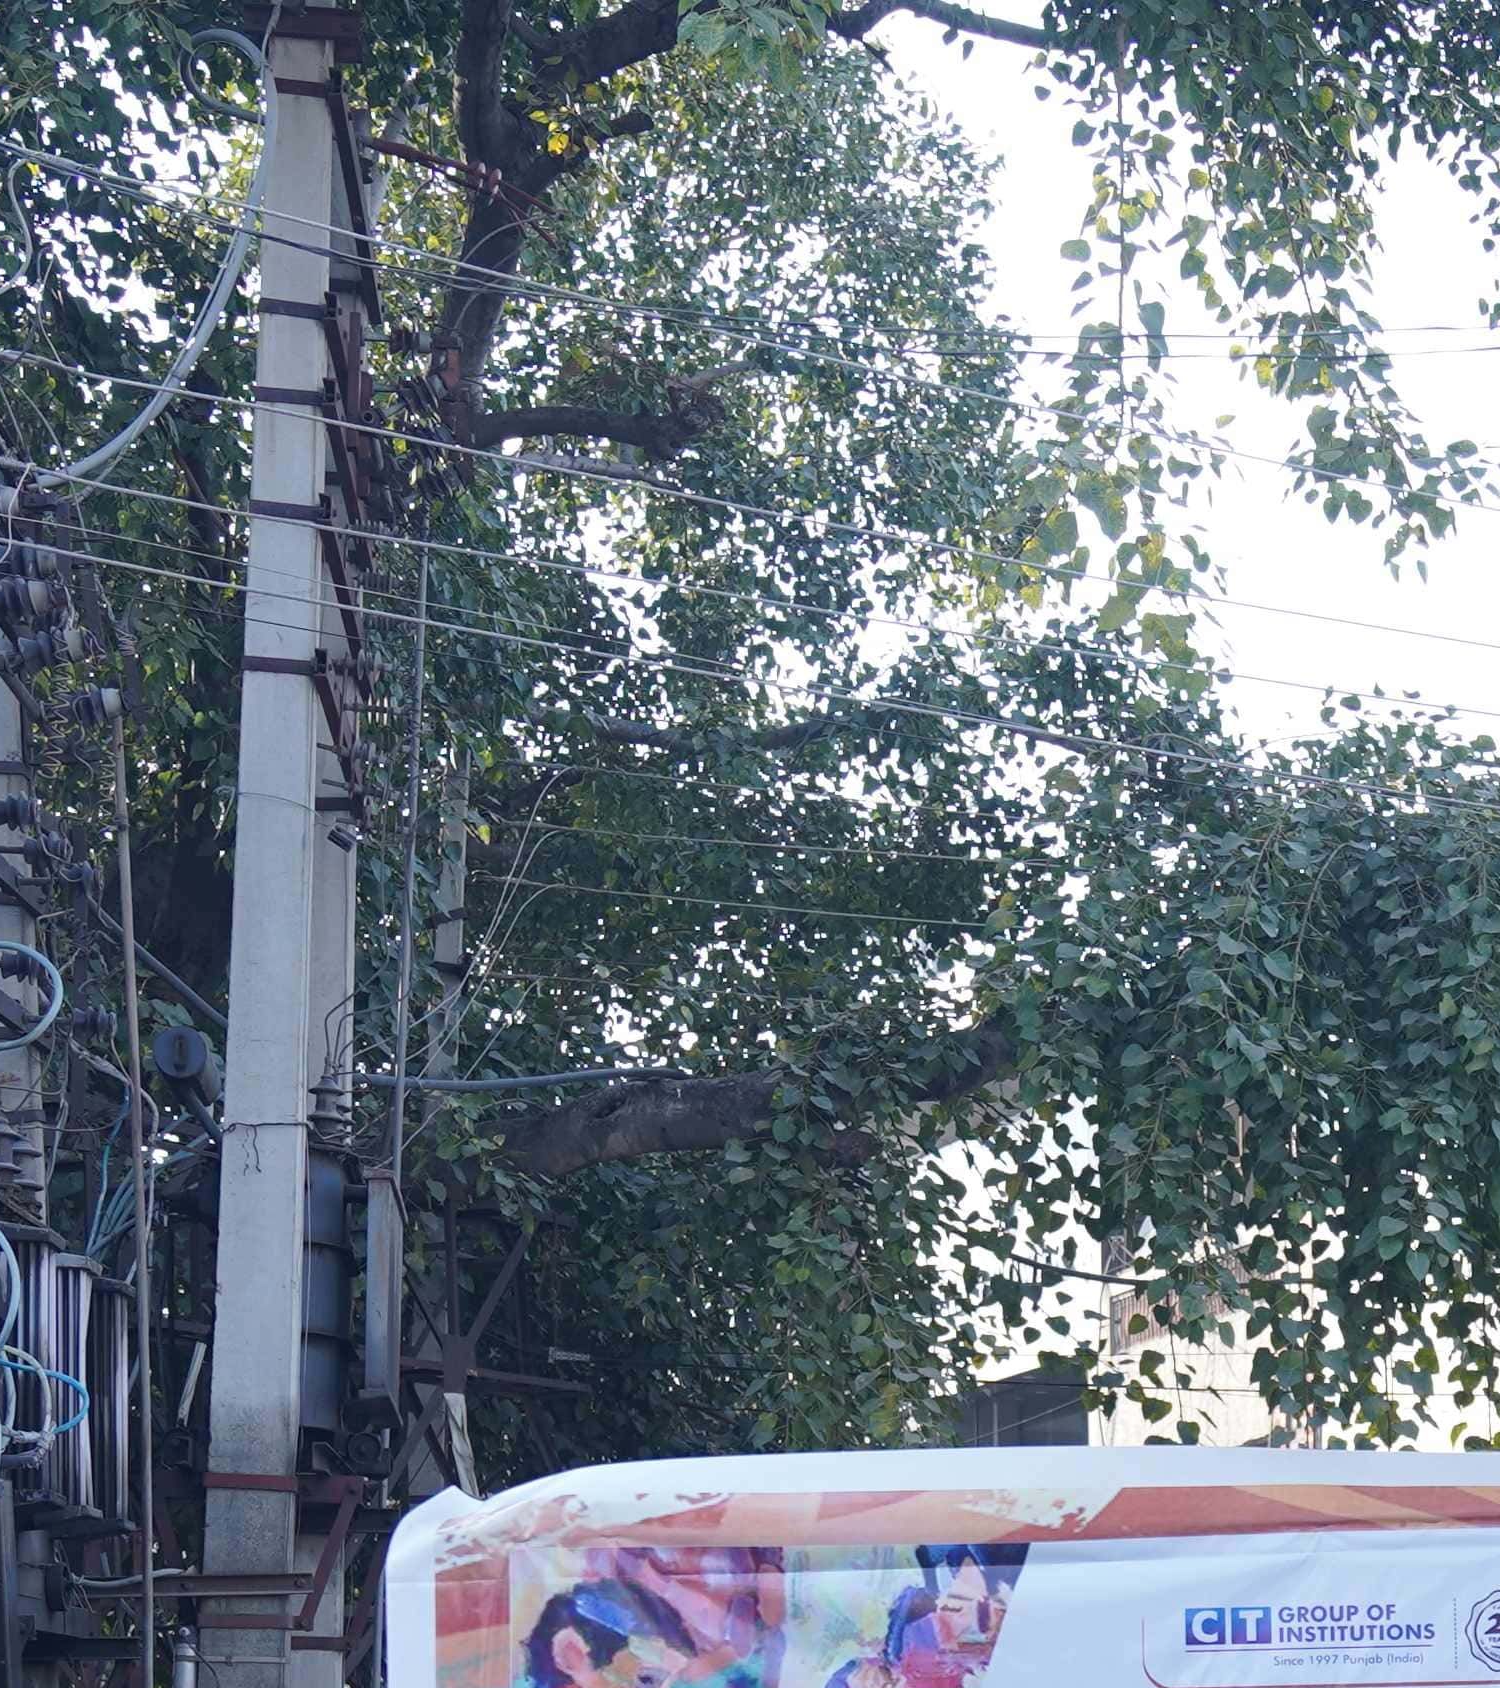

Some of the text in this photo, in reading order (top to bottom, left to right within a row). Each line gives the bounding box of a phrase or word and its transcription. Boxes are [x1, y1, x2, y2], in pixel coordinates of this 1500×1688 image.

[1278, 1604, 1396, 1623] GROUP OF
[1190, 1609, 1265, 1644] CT
[1278, 1623, 1436, 1643] INSTITUTIONS
[1273, 1652, 1425, 1667] Since 1997 Punjab (India)
